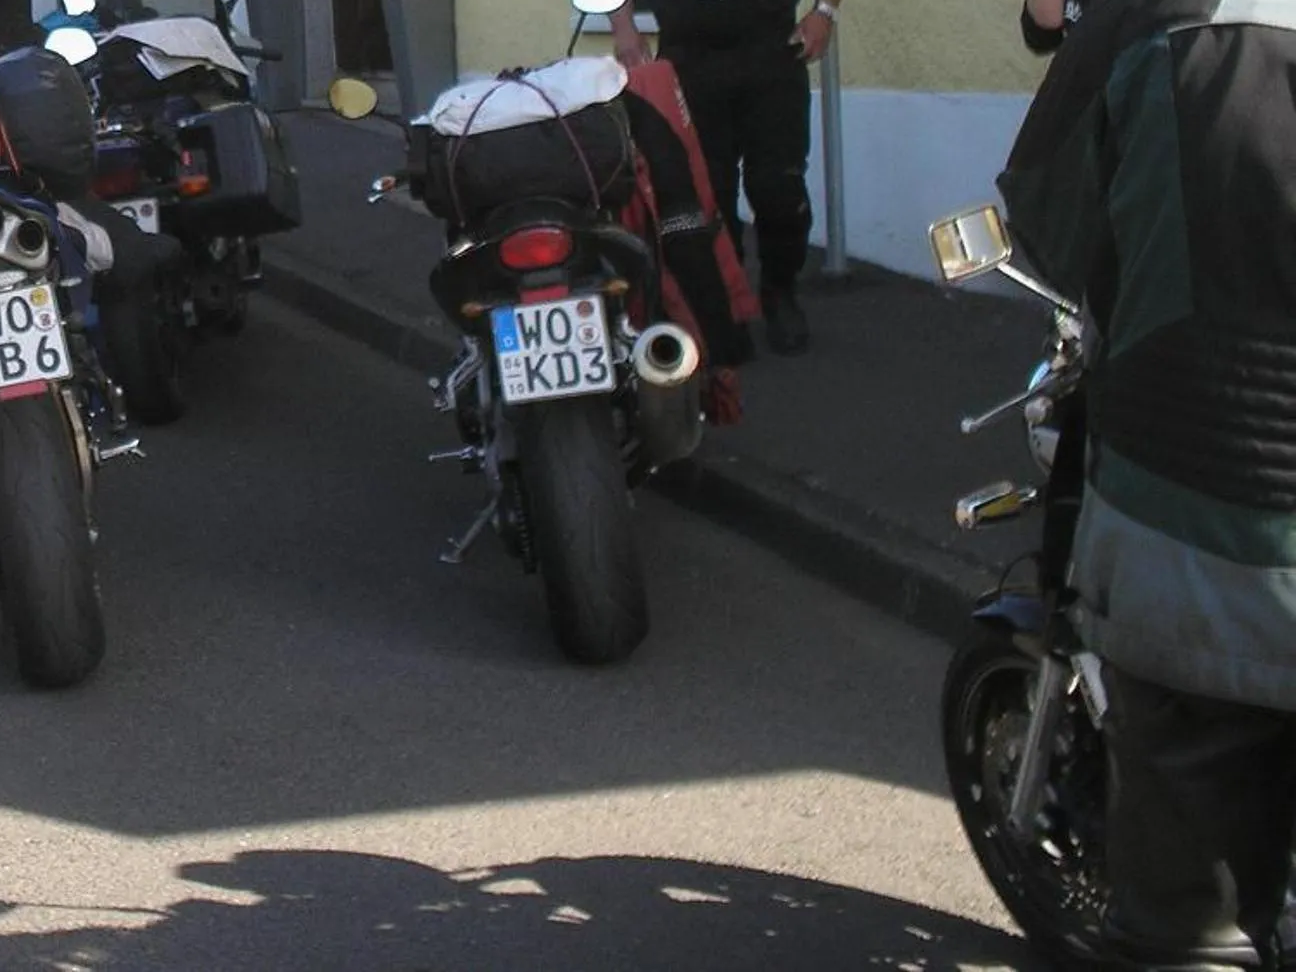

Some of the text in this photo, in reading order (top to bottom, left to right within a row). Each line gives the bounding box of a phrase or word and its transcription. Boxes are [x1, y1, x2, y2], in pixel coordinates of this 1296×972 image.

[516, 307, 572, 350] WO
[36, 335, 61, 373] 6
[524, 346, 609, 393] KD3
